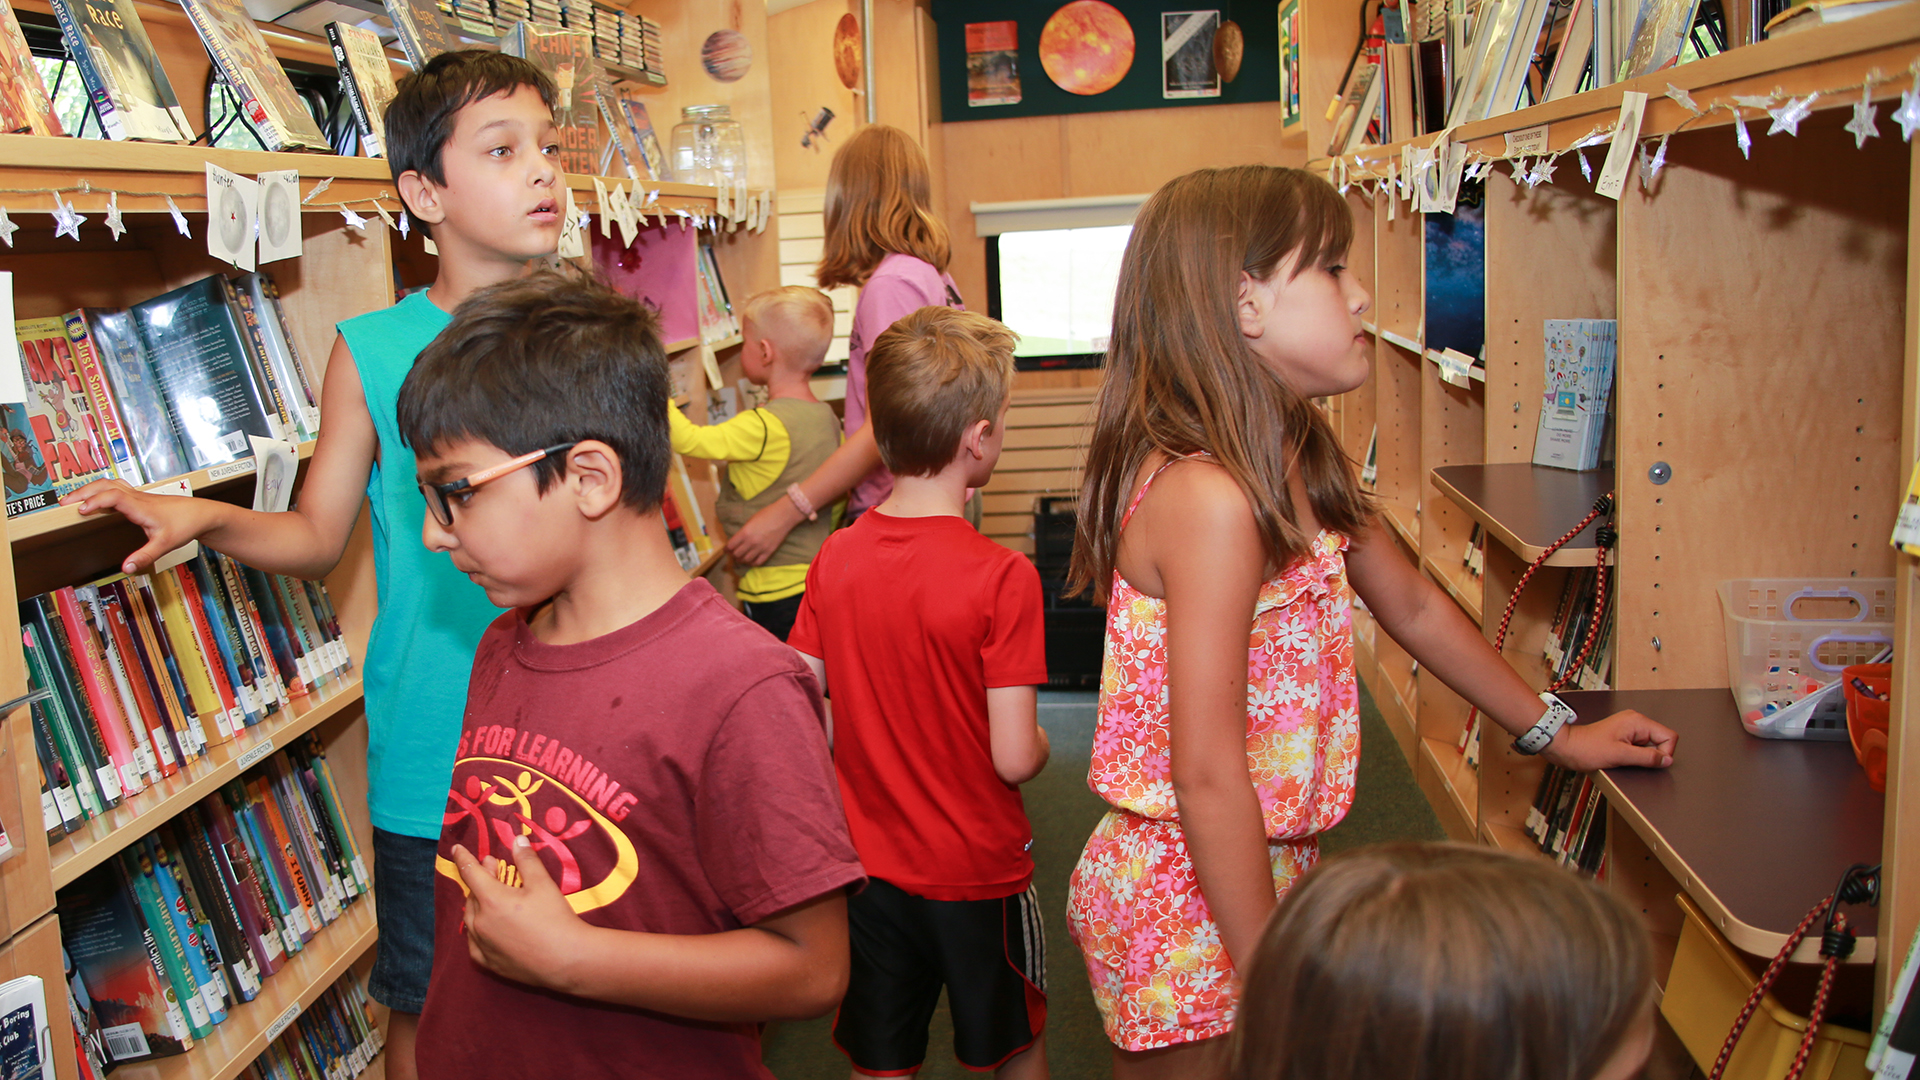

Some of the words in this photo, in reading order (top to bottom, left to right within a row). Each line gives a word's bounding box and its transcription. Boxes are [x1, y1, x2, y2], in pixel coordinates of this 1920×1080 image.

[85, 3, 124, 30] Race
[65, 24, 80, 47] Race
[189, 4, 222, 51] CLEOPATRA
[217, 49, 225, 60] IN
[222, 59, 244, 87] SPACE
[529, 33, 590, 58] PLANET
[557, 126, 600, 150] NDER-
[560, 150, 600, 175] RTEN
[70, 326, 82, 334] NEW
[22, 336, 84, 394] AKE
[257, 344, 275, 382] EMPEROR
[76, 341, 96, 371] Just
[88, 373, 110, 412] South
[103, 414, 114, 424] of
[272, 388, 290, 425] UNIVERS
[29, 414, 112, 482] FAKE
[210, 469, 220, 478] NEW
[221, 465, 238, 476] JUVENILE
[238, 462, 253, 471] FICTION
[24, 494, 46, 514] PRICE
[189, 583, 199, 607] HENRY
[230, 584, 241, 604] TEXT
[239, 607, 251, 632] DEAD
[294, 603, 303, 620] BUT
[191, 631, 201, 652] Henry
[205, 669, 216, 694] Beezus
[240, 750, 258, 766] JUVENILE
[257, 742, 272, 754] FICTION
[472, 724, 516, 757] FOR
[516, 731, 639, 823] LEARNING
[247, 862, 256, 882] Jekyll
[266, 913, 275, 930] Hyde
[294, 869, 314, 908] FUNNY
[176, 896, 189, 914] UP
[156, 896, 185, 958] HURRICANE
[188, 933, 199, 947] AIR
[144, 927, 164, 976] WATCHDOG
[3, 1010, 30, 1029] Boring
[268, 1016, 286, 1038] JUVENILE
[285, 1007, 298, 1023] FICTION
[2, 1031, 20, 1046] Club
